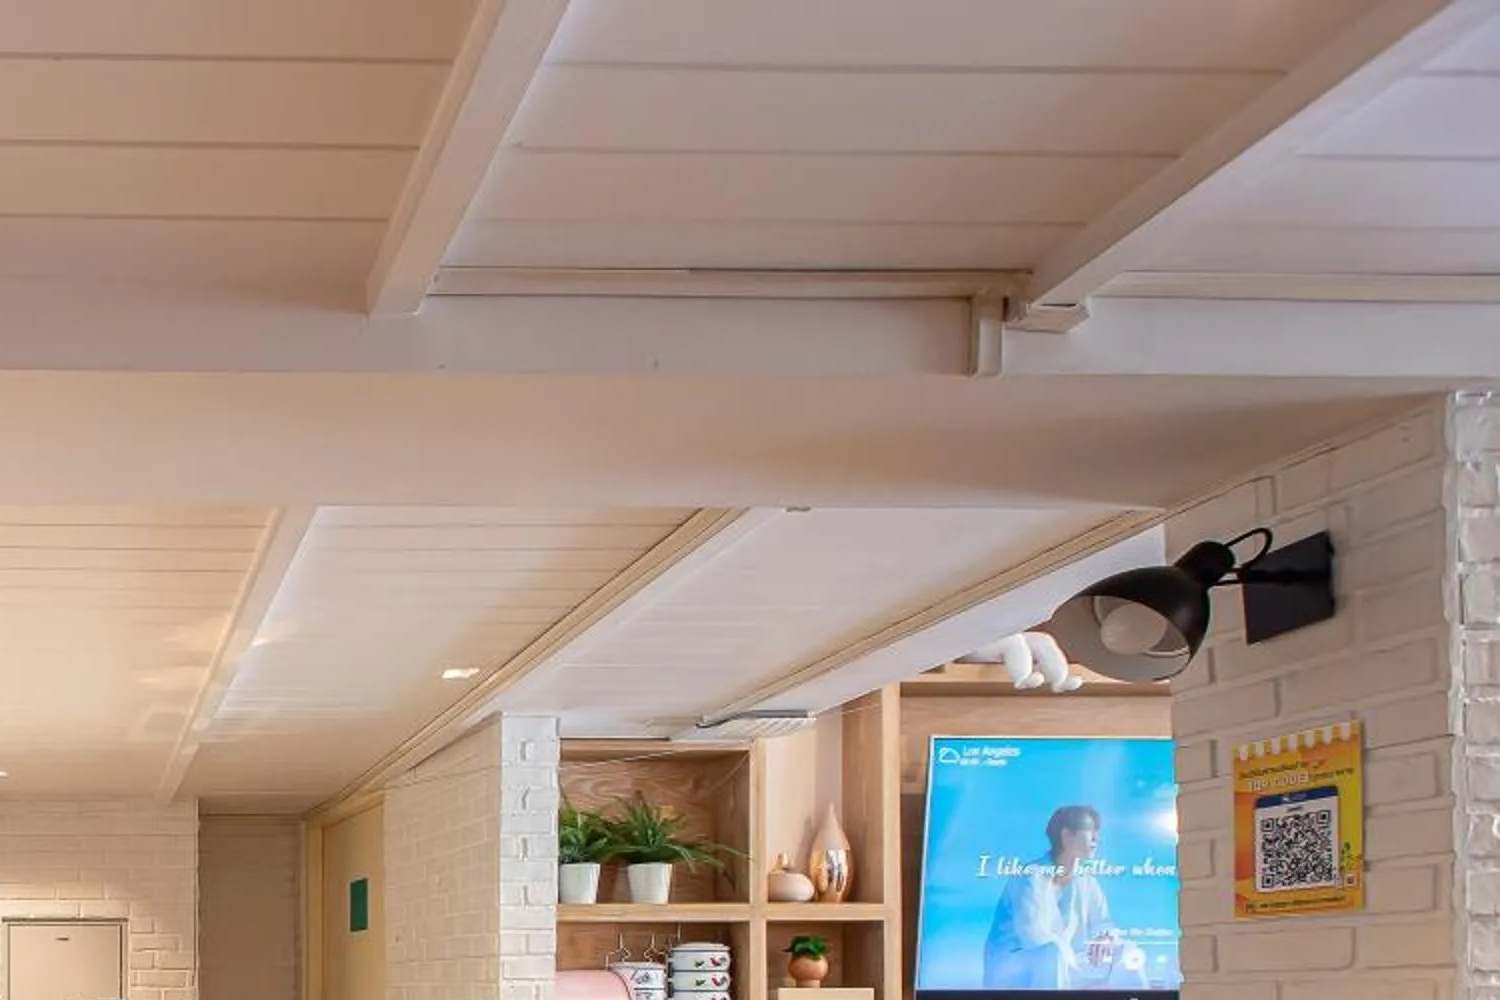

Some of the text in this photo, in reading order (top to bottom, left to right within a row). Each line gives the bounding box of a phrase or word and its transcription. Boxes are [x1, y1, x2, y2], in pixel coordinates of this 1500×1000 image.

[976, 854, 990, 878] I
[996, 857, 1032, 877] like
[1073, 857, 1126, 877] better
[1132, 858, 1177, 877] when
